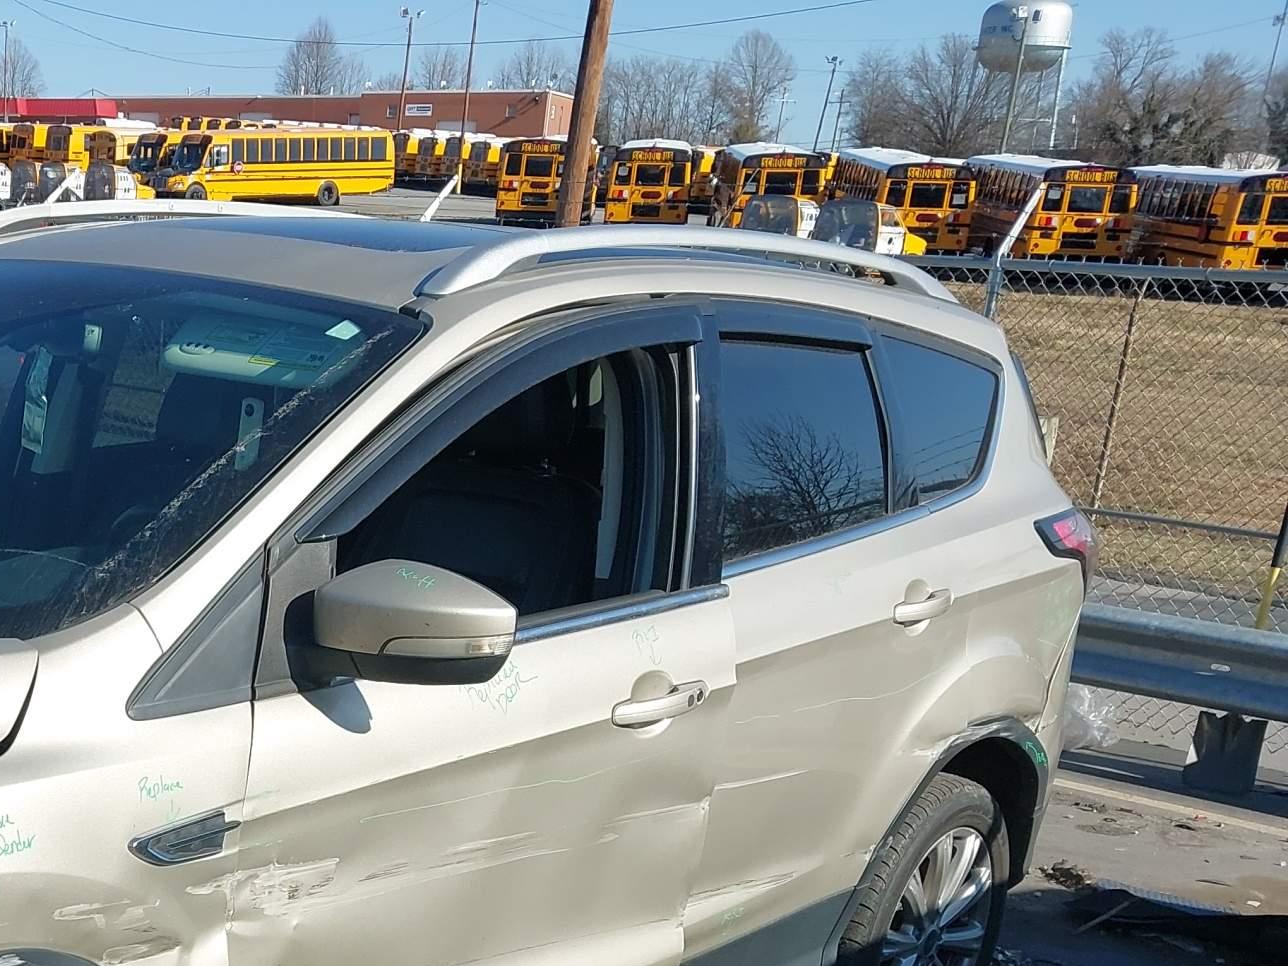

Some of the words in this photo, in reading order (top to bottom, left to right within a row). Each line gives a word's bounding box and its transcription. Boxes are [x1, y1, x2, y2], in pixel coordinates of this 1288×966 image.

[632, 151, 661, 161] SCHOOL
[762, 157, 793, 167] SCHOOL
[908, 167, 942, 178] SCHOOL
[943, 168, 957, 179] BUS
[1067, 171, 1100, 182] SCHOOL
[1101, 172, 1117, 182] BUS
